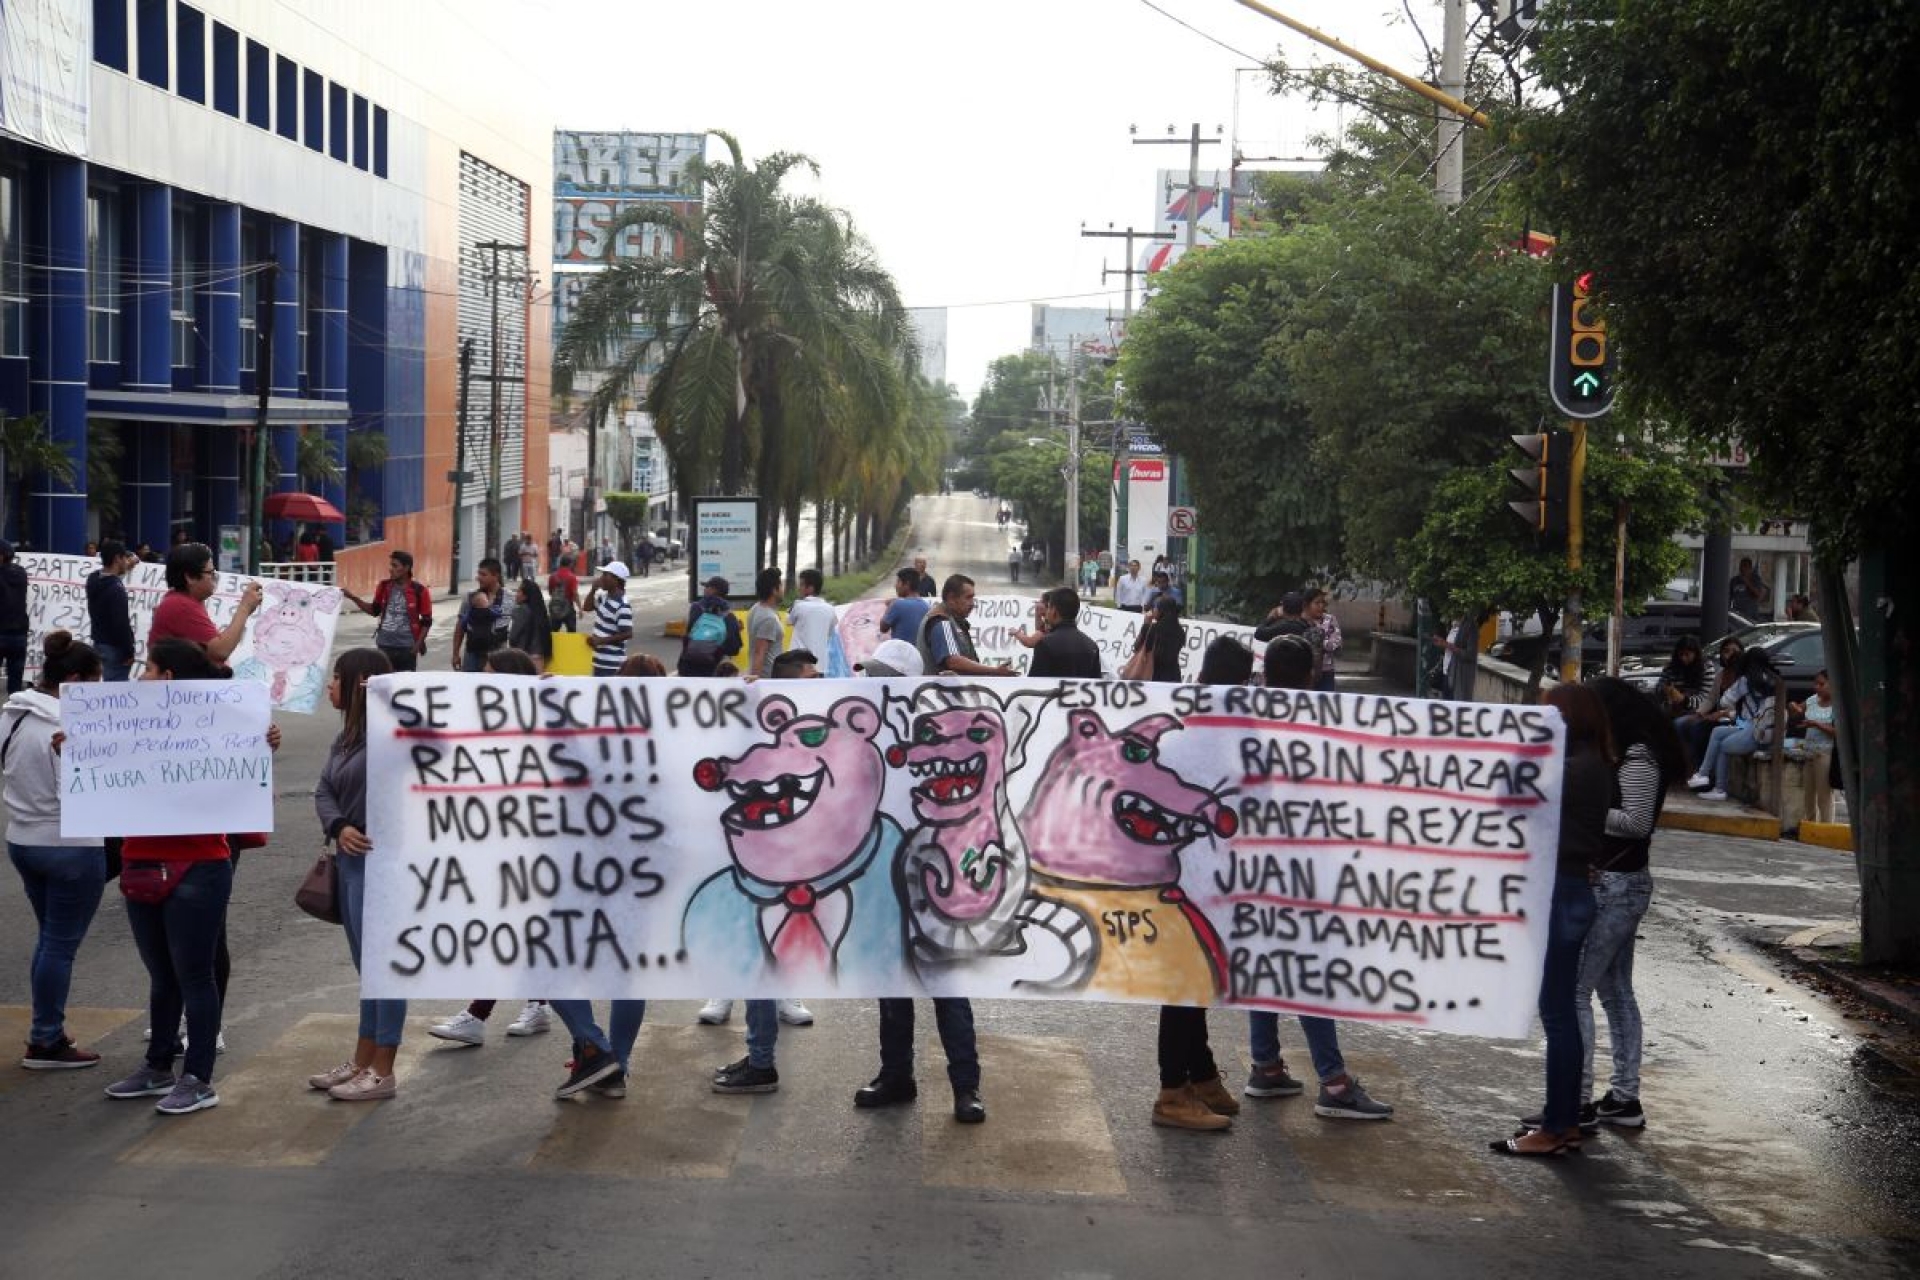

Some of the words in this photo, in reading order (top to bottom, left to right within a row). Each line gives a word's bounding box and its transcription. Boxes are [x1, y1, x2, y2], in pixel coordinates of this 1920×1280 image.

[68, 685, 139, 712] Somos
[157, 684, 243, 711] Jovenes
[68, 706, 182, 742] construyendo
[198, 711, 217, 730] el
[391, 686, 451, 729] SE
[476, 685, 652, 732] BUSCAN
[666, 688, 753, 729] POR
[1057, 680, 1148, 708] ESTOS
[1170, 684, 1212, 717] SE
[1226, 686, 1346, 726] ROBAN
[1355, 696, 1423, 735] LAS
[1430, 704, 1554, 742] BECAS
[1240, 739, 1365, 783] RABIN
[1380, 749, 1548, 801] SALAZAR
[427, 793, 664, 842] MORELOS
[1240, 798, 1377, 839] RAFAEL
[1388, 805, 1525, 848] REYES
[409, 856, 474, 910] YA
[499, 854, 560, 908] NO
[573, 852, 664, 897] LOS
[1215, 851, 1315, 899] JUAN
[1335, 850, 1475, 913] ÁNGEL
[1501, 875, 1526, 919] F.
[1102, 908, 1157, 945] STPS
[1231, 903, 1505, 961] BUSTAMANTE
